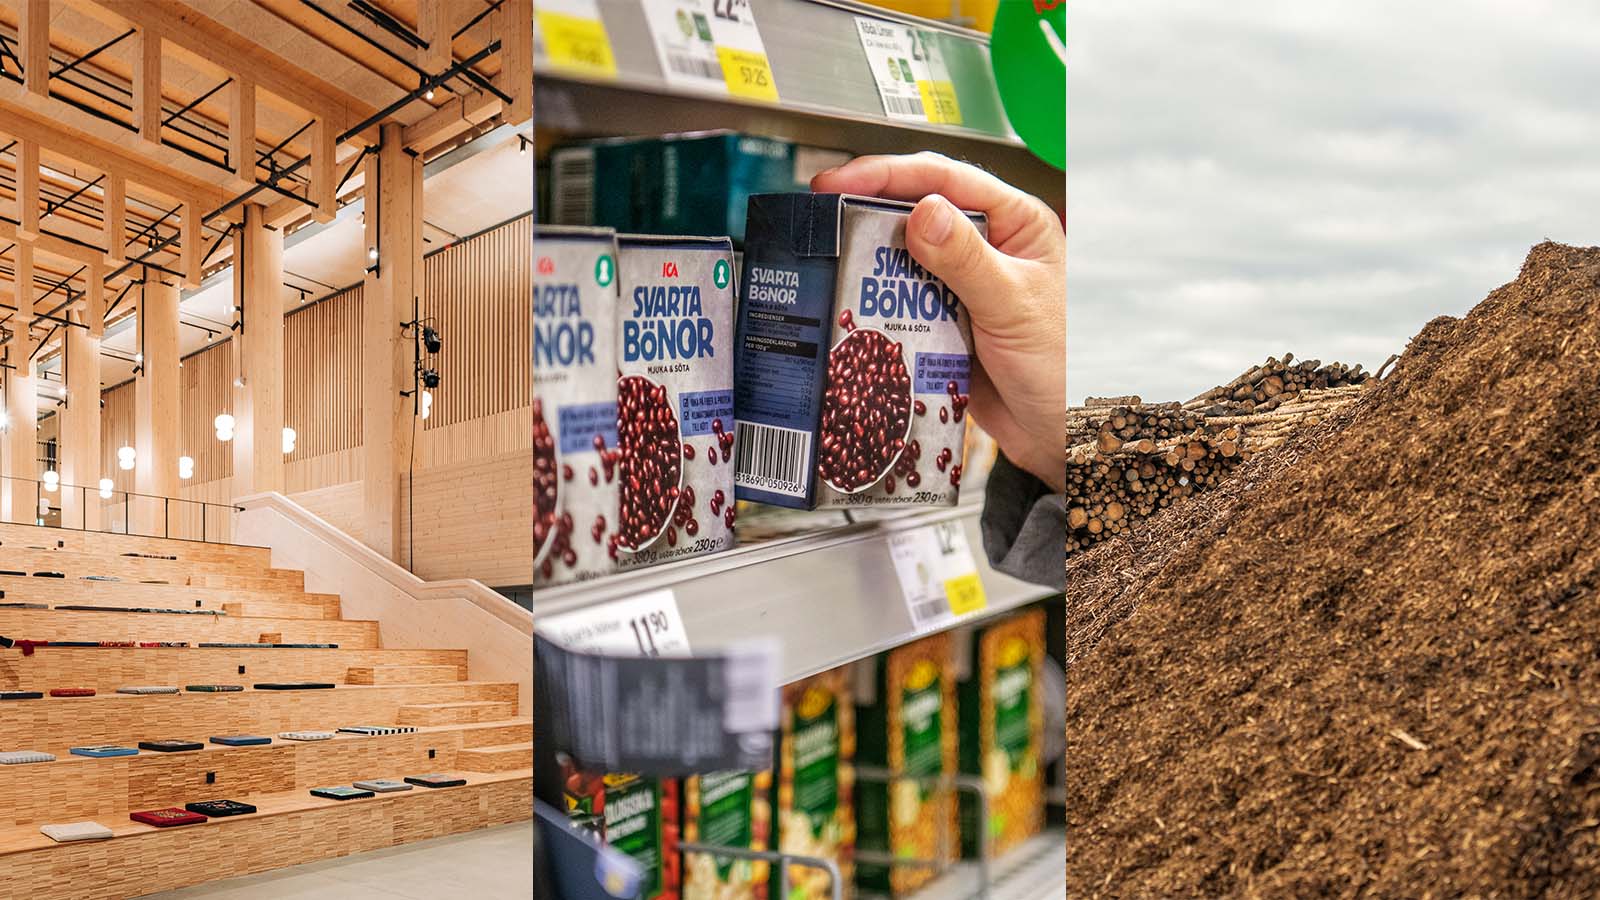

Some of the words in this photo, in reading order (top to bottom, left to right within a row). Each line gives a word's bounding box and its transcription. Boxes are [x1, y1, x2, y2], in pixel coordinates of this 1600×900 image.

[662, 262, 679, 278] ICA
[751, 267, 800, 288] SVARTA
[633, 286, 702, 318] SVARTA
[884, 323, 906, 332] MJUKA
[914, 323, 931, 333] SÖTA
[648, 365, 668, 375] MJUKA
[669, 364, 674, 373] &
[675, 362, 690, 373] SÖTA
[767, 478, 799, 493] 050926
